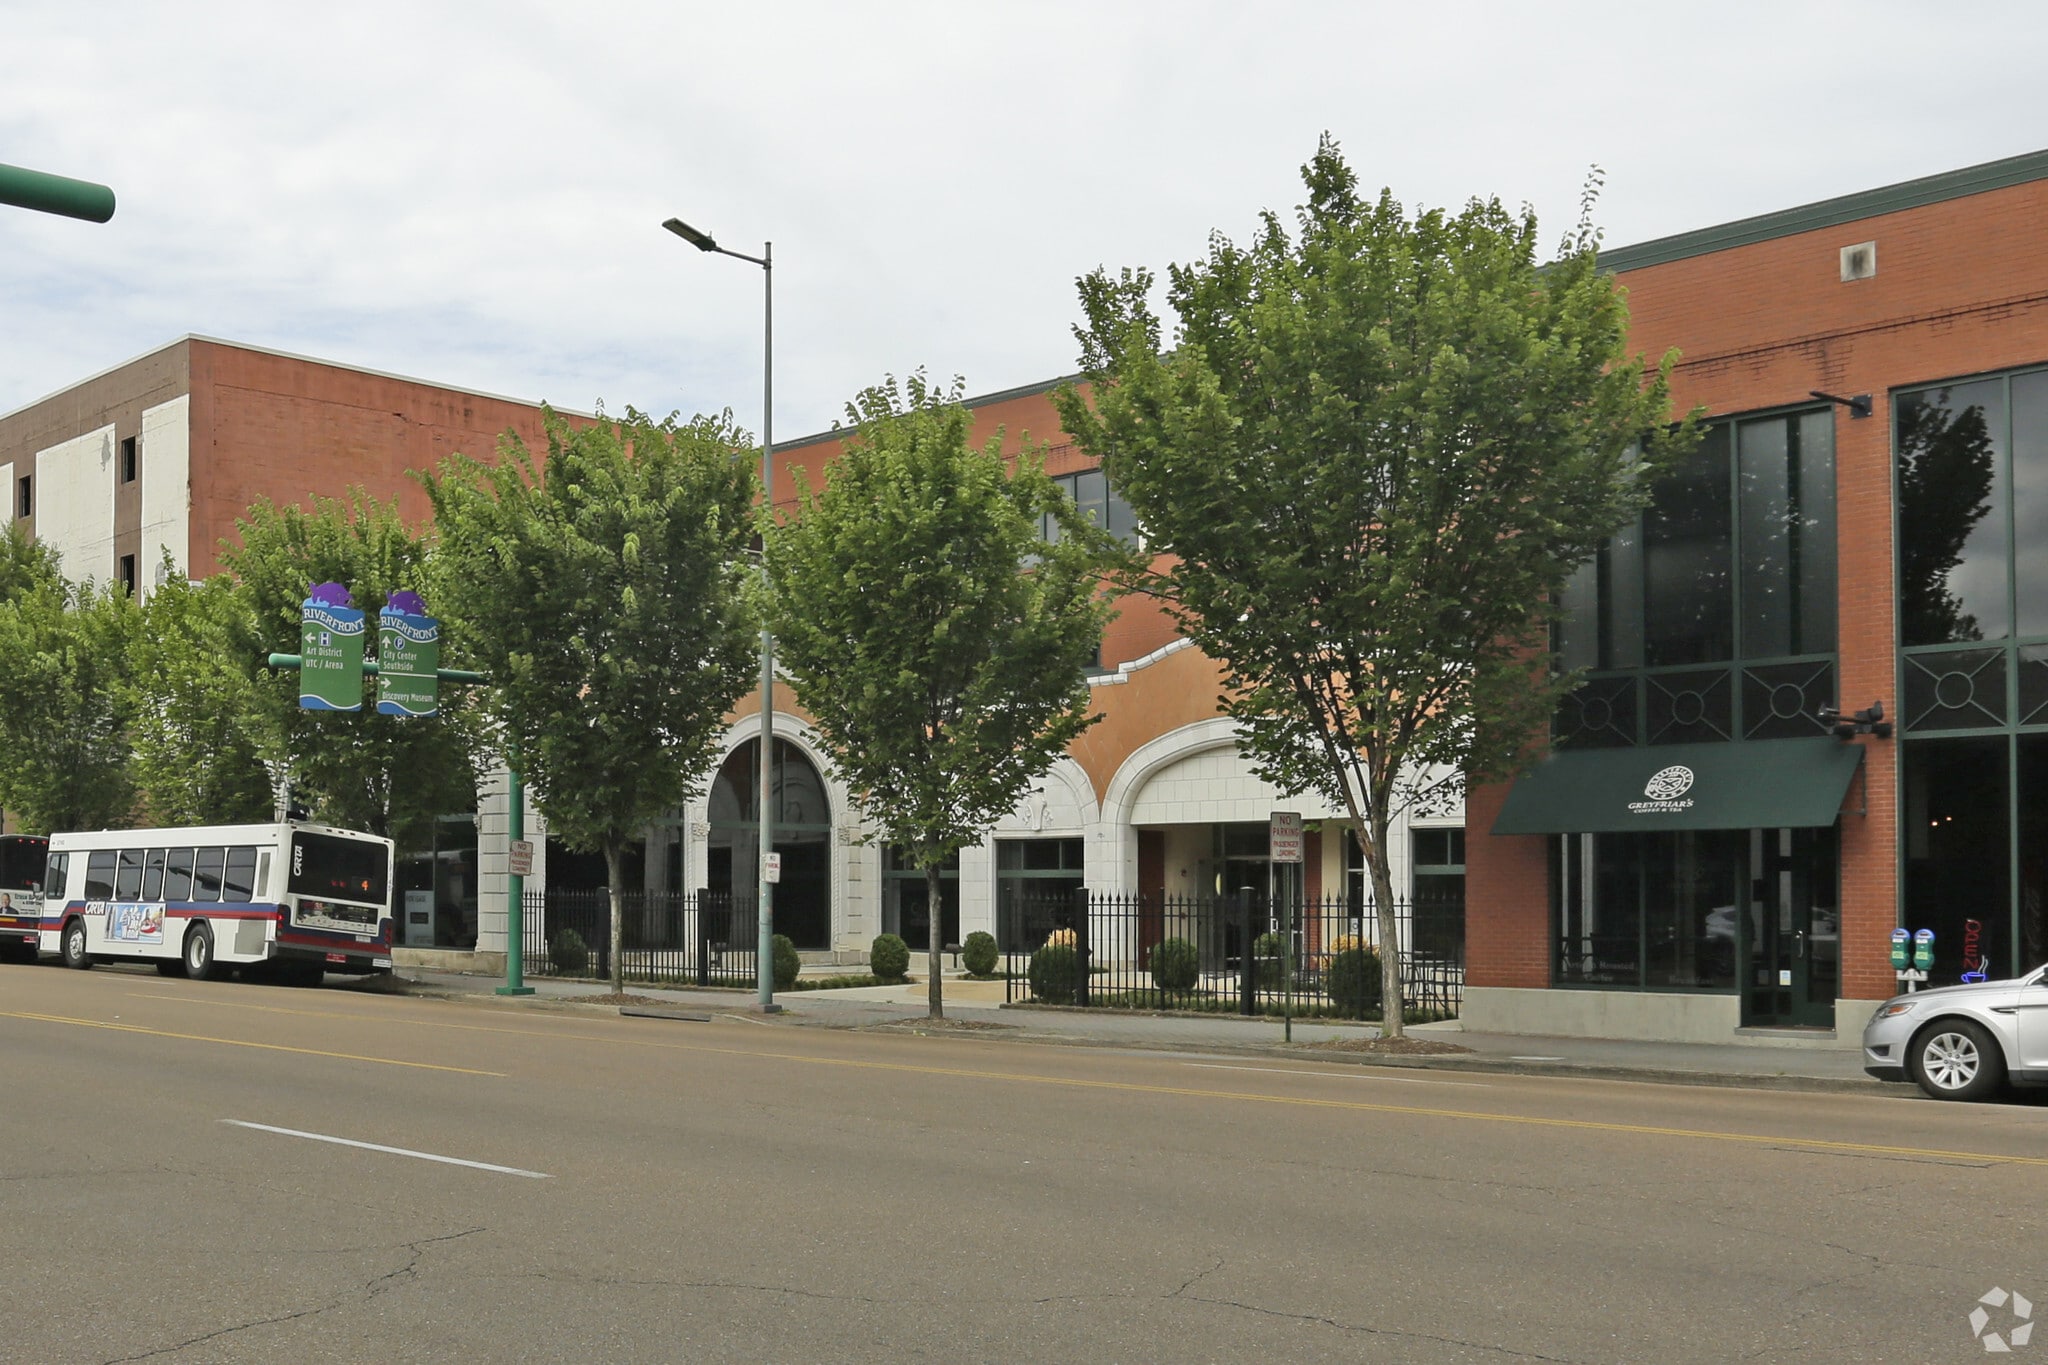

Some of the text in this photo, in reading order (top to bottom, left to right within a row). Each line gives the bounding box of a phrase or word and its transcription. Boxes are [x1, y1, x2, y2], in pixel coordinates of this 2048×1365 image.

[303, 608, 364, 632] RIVERFRONT
[380, 616, 438, 640] RIVERFRONT
[306, 647, 342, 657] Art District
[384, 651, 416, 660] City Center
[306, 659, 317, 668] UTC
[325, 661, 344, 669] Arena
[383, 661, 413, 671] Southside
[382, 691, 433, 702] Discovery Museum
[1628, 798, 1694, 809] GREYFRIAR'S
[1279, 815, 1291, 825] NO
[1273, 827, 1299, 837] PARKING
[361, 880, 368, 890] 4
[1964, 919, 1982, 969] OPEN
